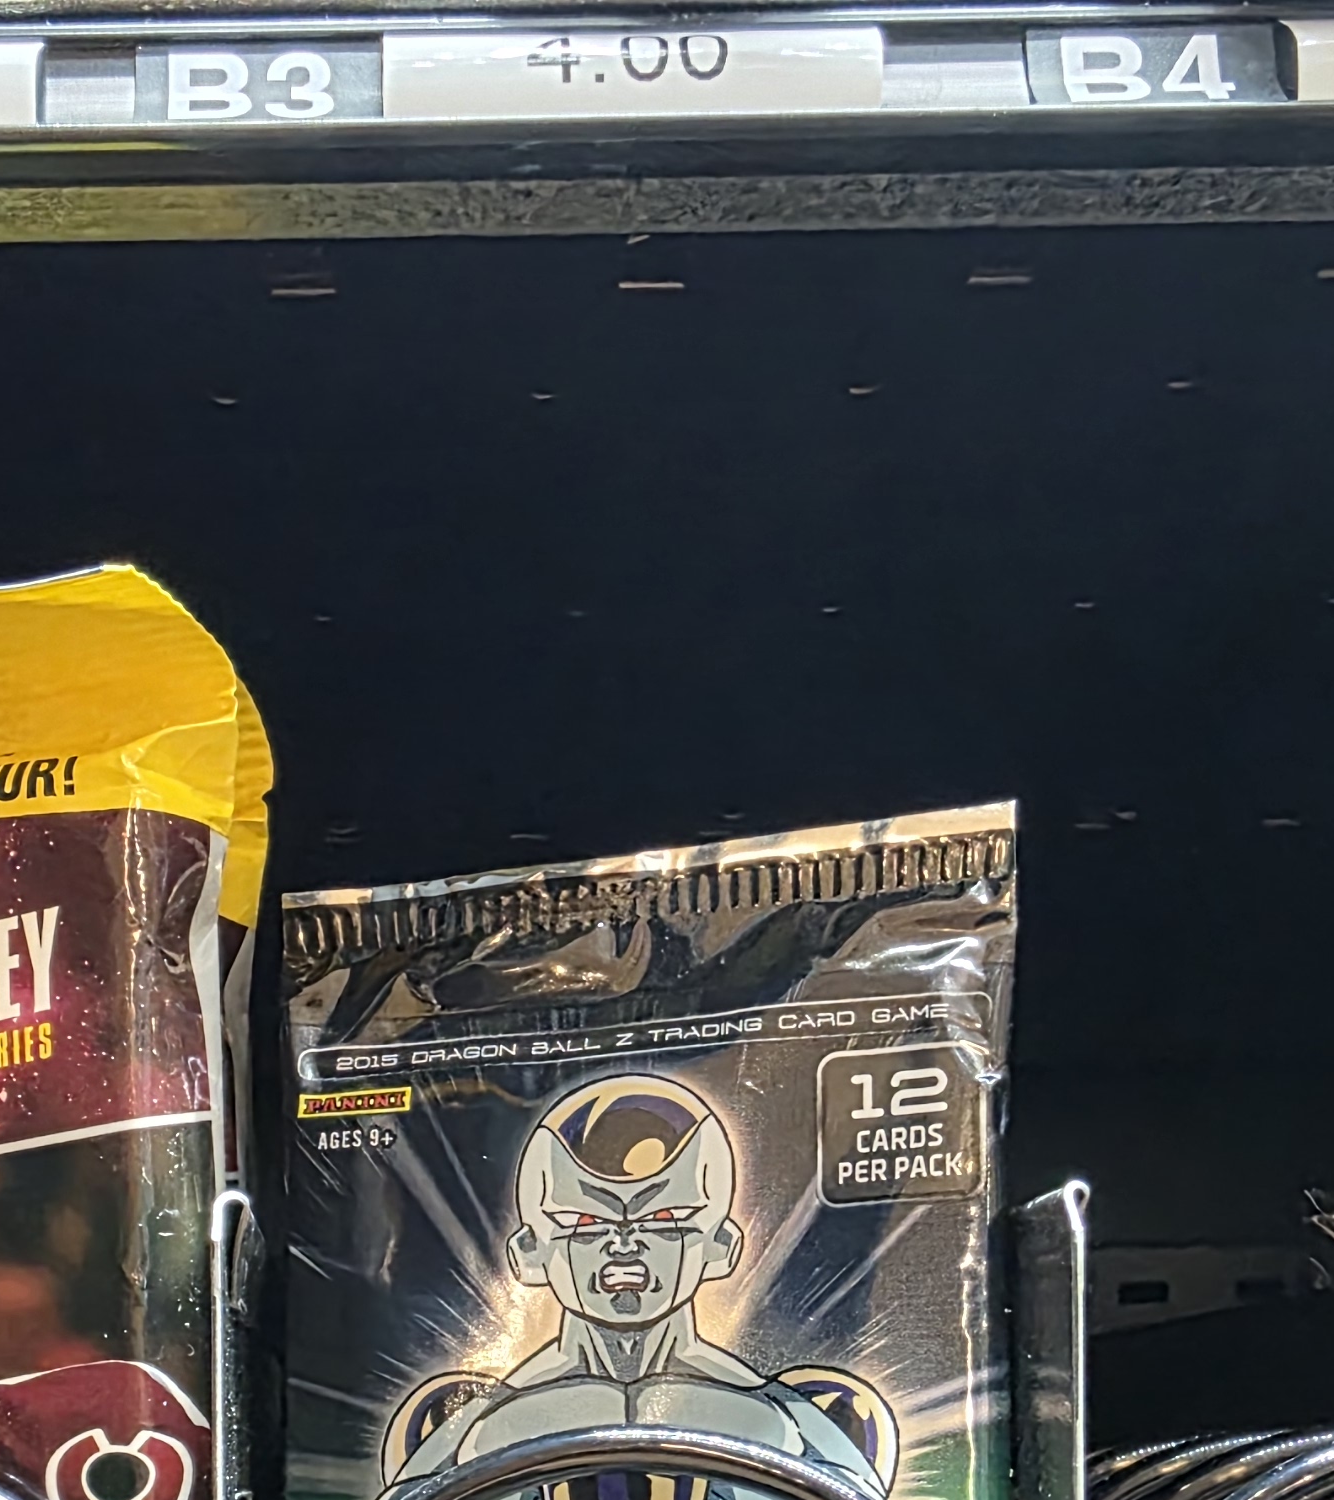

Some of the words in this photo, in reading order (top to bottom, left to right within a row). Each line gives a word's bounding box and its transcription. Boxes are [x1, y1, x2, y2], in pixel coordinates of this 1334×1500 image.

[526, 33, 729, 84] 4.00
[1063, 34, 1237, 102] B4
[166, 51, 335, 121] B3
[335, 1053, 399, 1071] 2015
[410, 1043, 517, 1066] DRAGON
[531, 1036, 601, 1056] BALL
[616, 1032, 634, 1047] Z
[649, 1017, 763, 1044] TRADING
[778, 1010, 856, 1030] CARD
[872, 1003, 950, 1024] GAME
[303, 1091, 407, 1115] PANINI
[851, 1067, 949, 1120] 12
[318, 1129, 362, 1151] AGES
[370, 1127, 397, 1148] 9+
[856, 1123, 944, 1154] CARDS
[838, 1158, 886, 1185] PER
[894, 1151, 963, 1180] PACK
